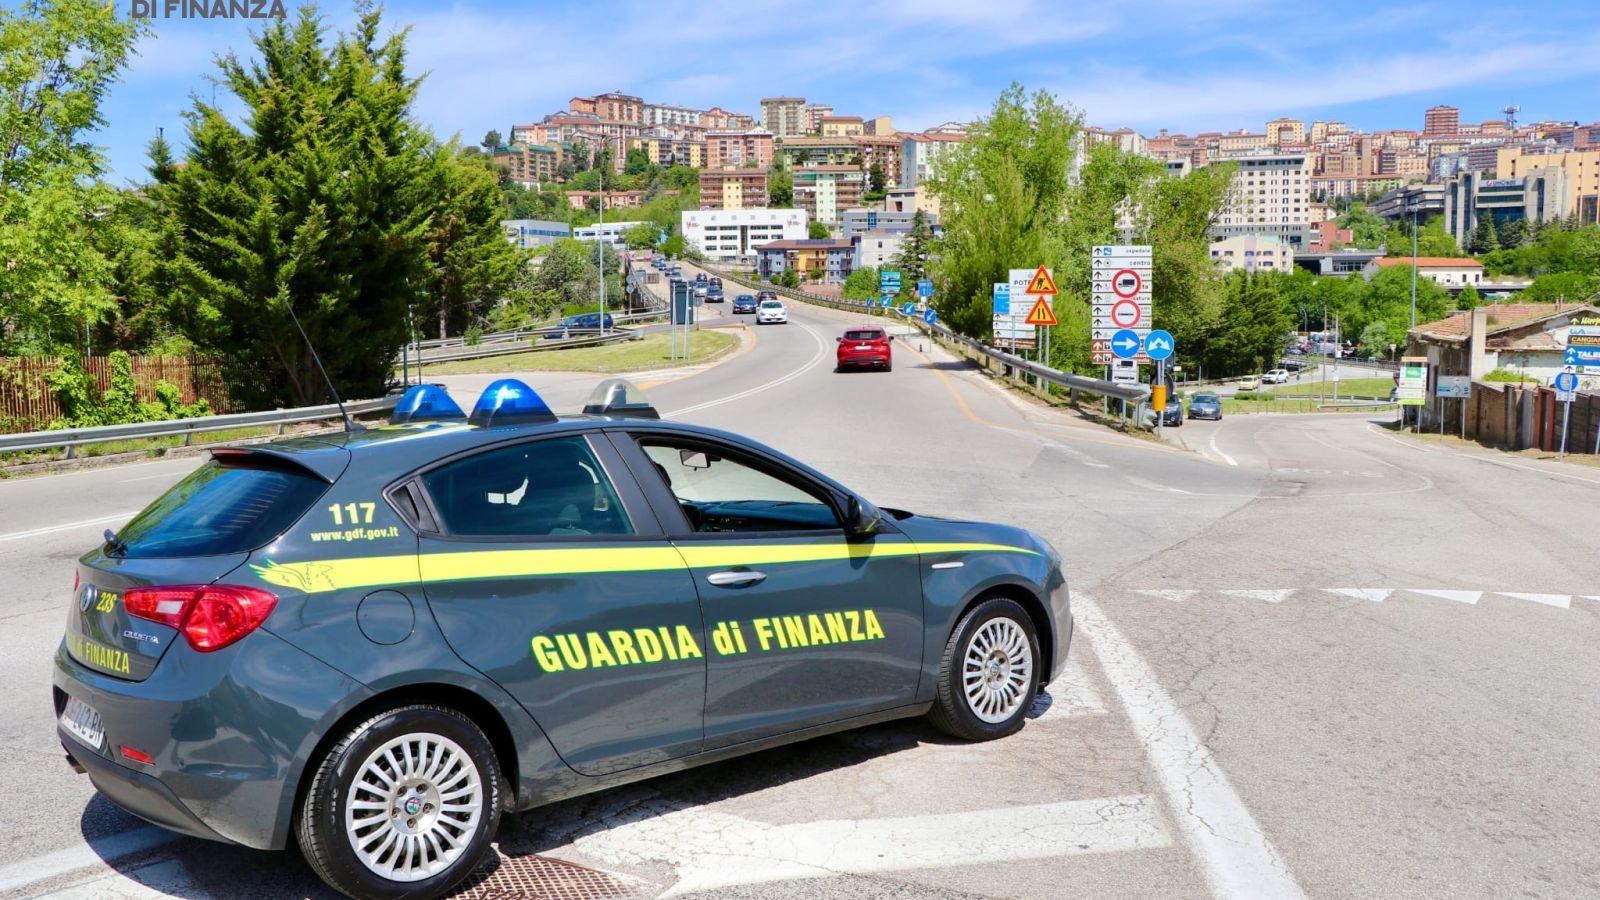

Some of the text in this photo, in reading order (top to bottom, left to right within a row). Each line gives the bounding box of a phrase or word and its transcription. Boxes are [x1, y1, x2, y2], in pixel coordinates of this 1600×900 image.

[328, 502, 376, 525] 117
[310, 526, 399, 542] www.gdf.gov.it
[531, 609, 885, 673] GUARDIA di FINANZA
[85, 641, 130, 674] FINANZA
